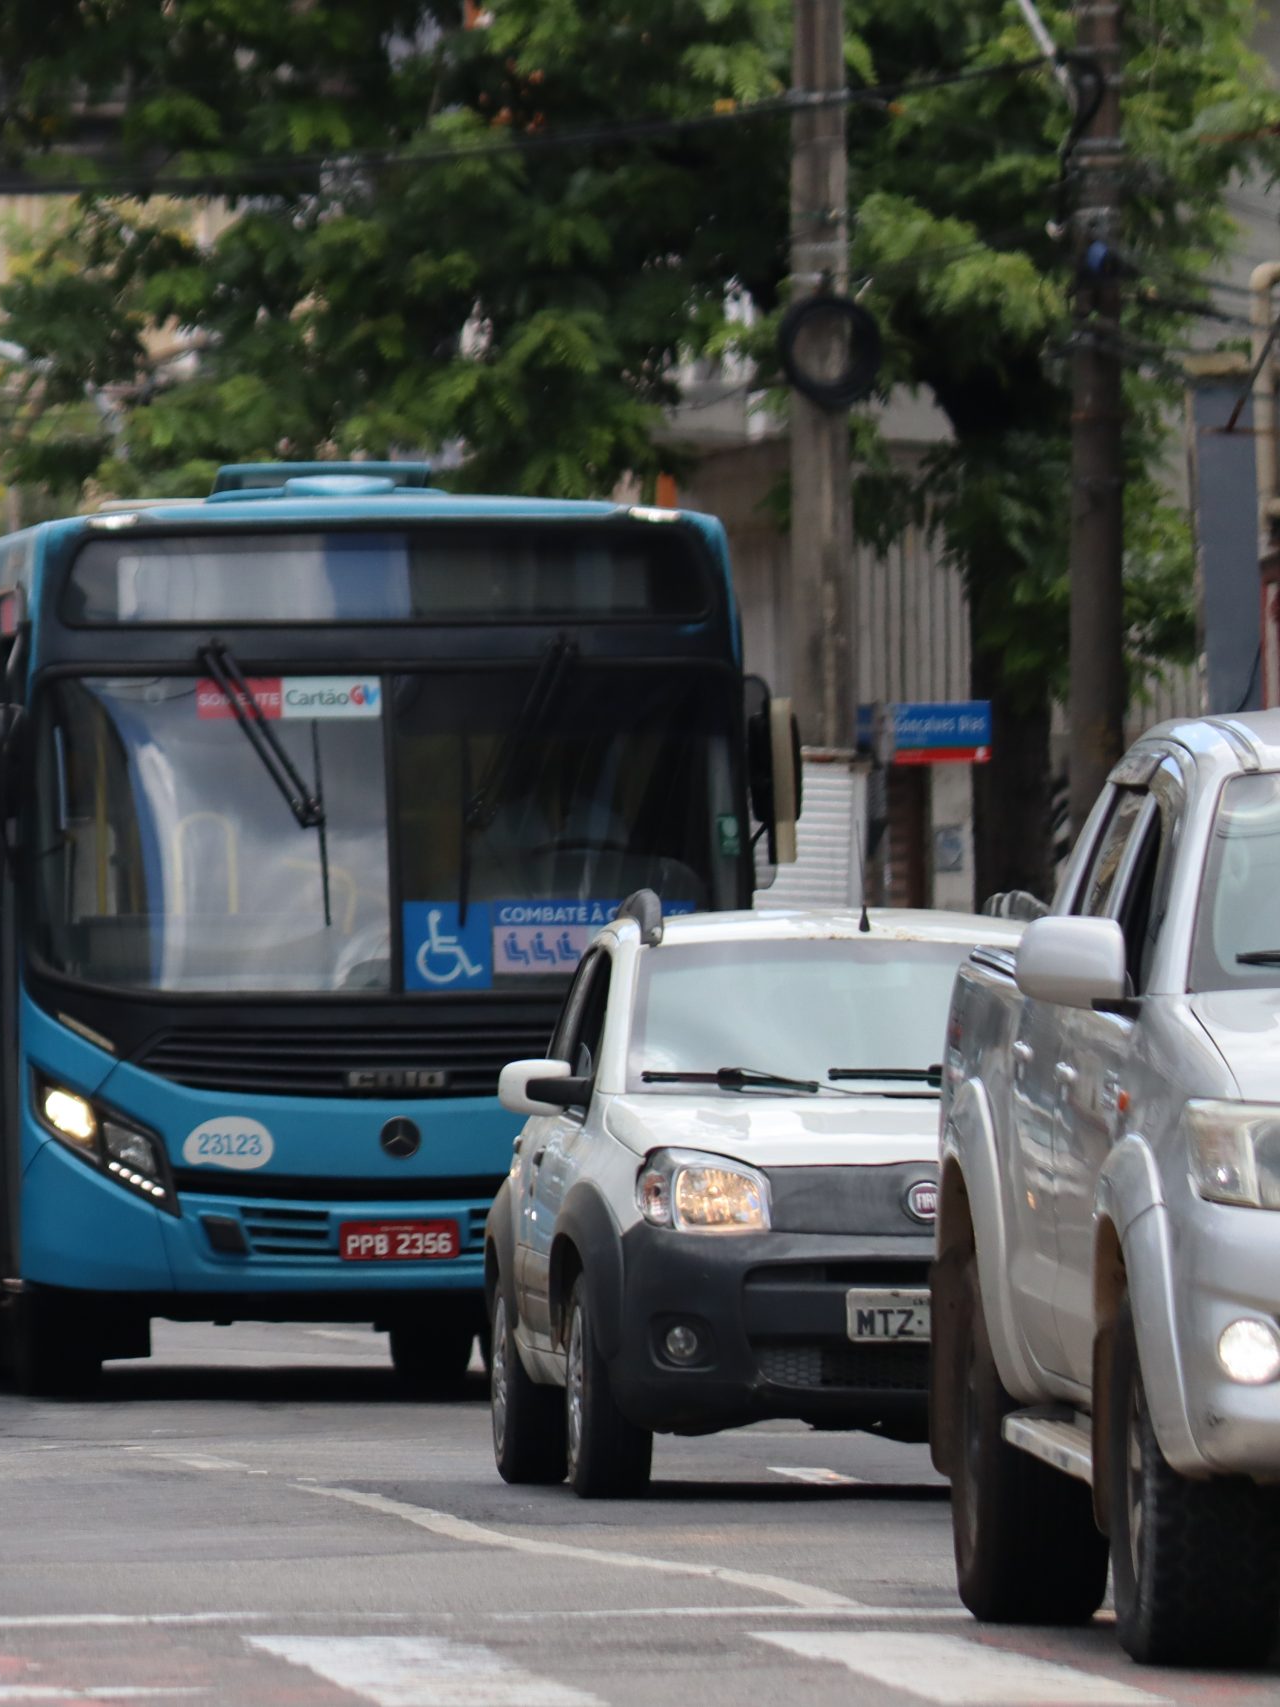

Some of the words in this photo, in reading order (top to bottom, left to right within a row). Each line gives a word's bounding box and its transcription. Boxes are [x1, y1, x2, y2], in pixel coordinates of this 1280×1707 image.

[285, 688, 350, 706] Cartão
[499, 906, 588, 922] COMBATE
[197, 1133, 264, 1155] 23123
[346, 1234, 389, 1255] PPB
[395, 1232, 453, 1255] 2356
